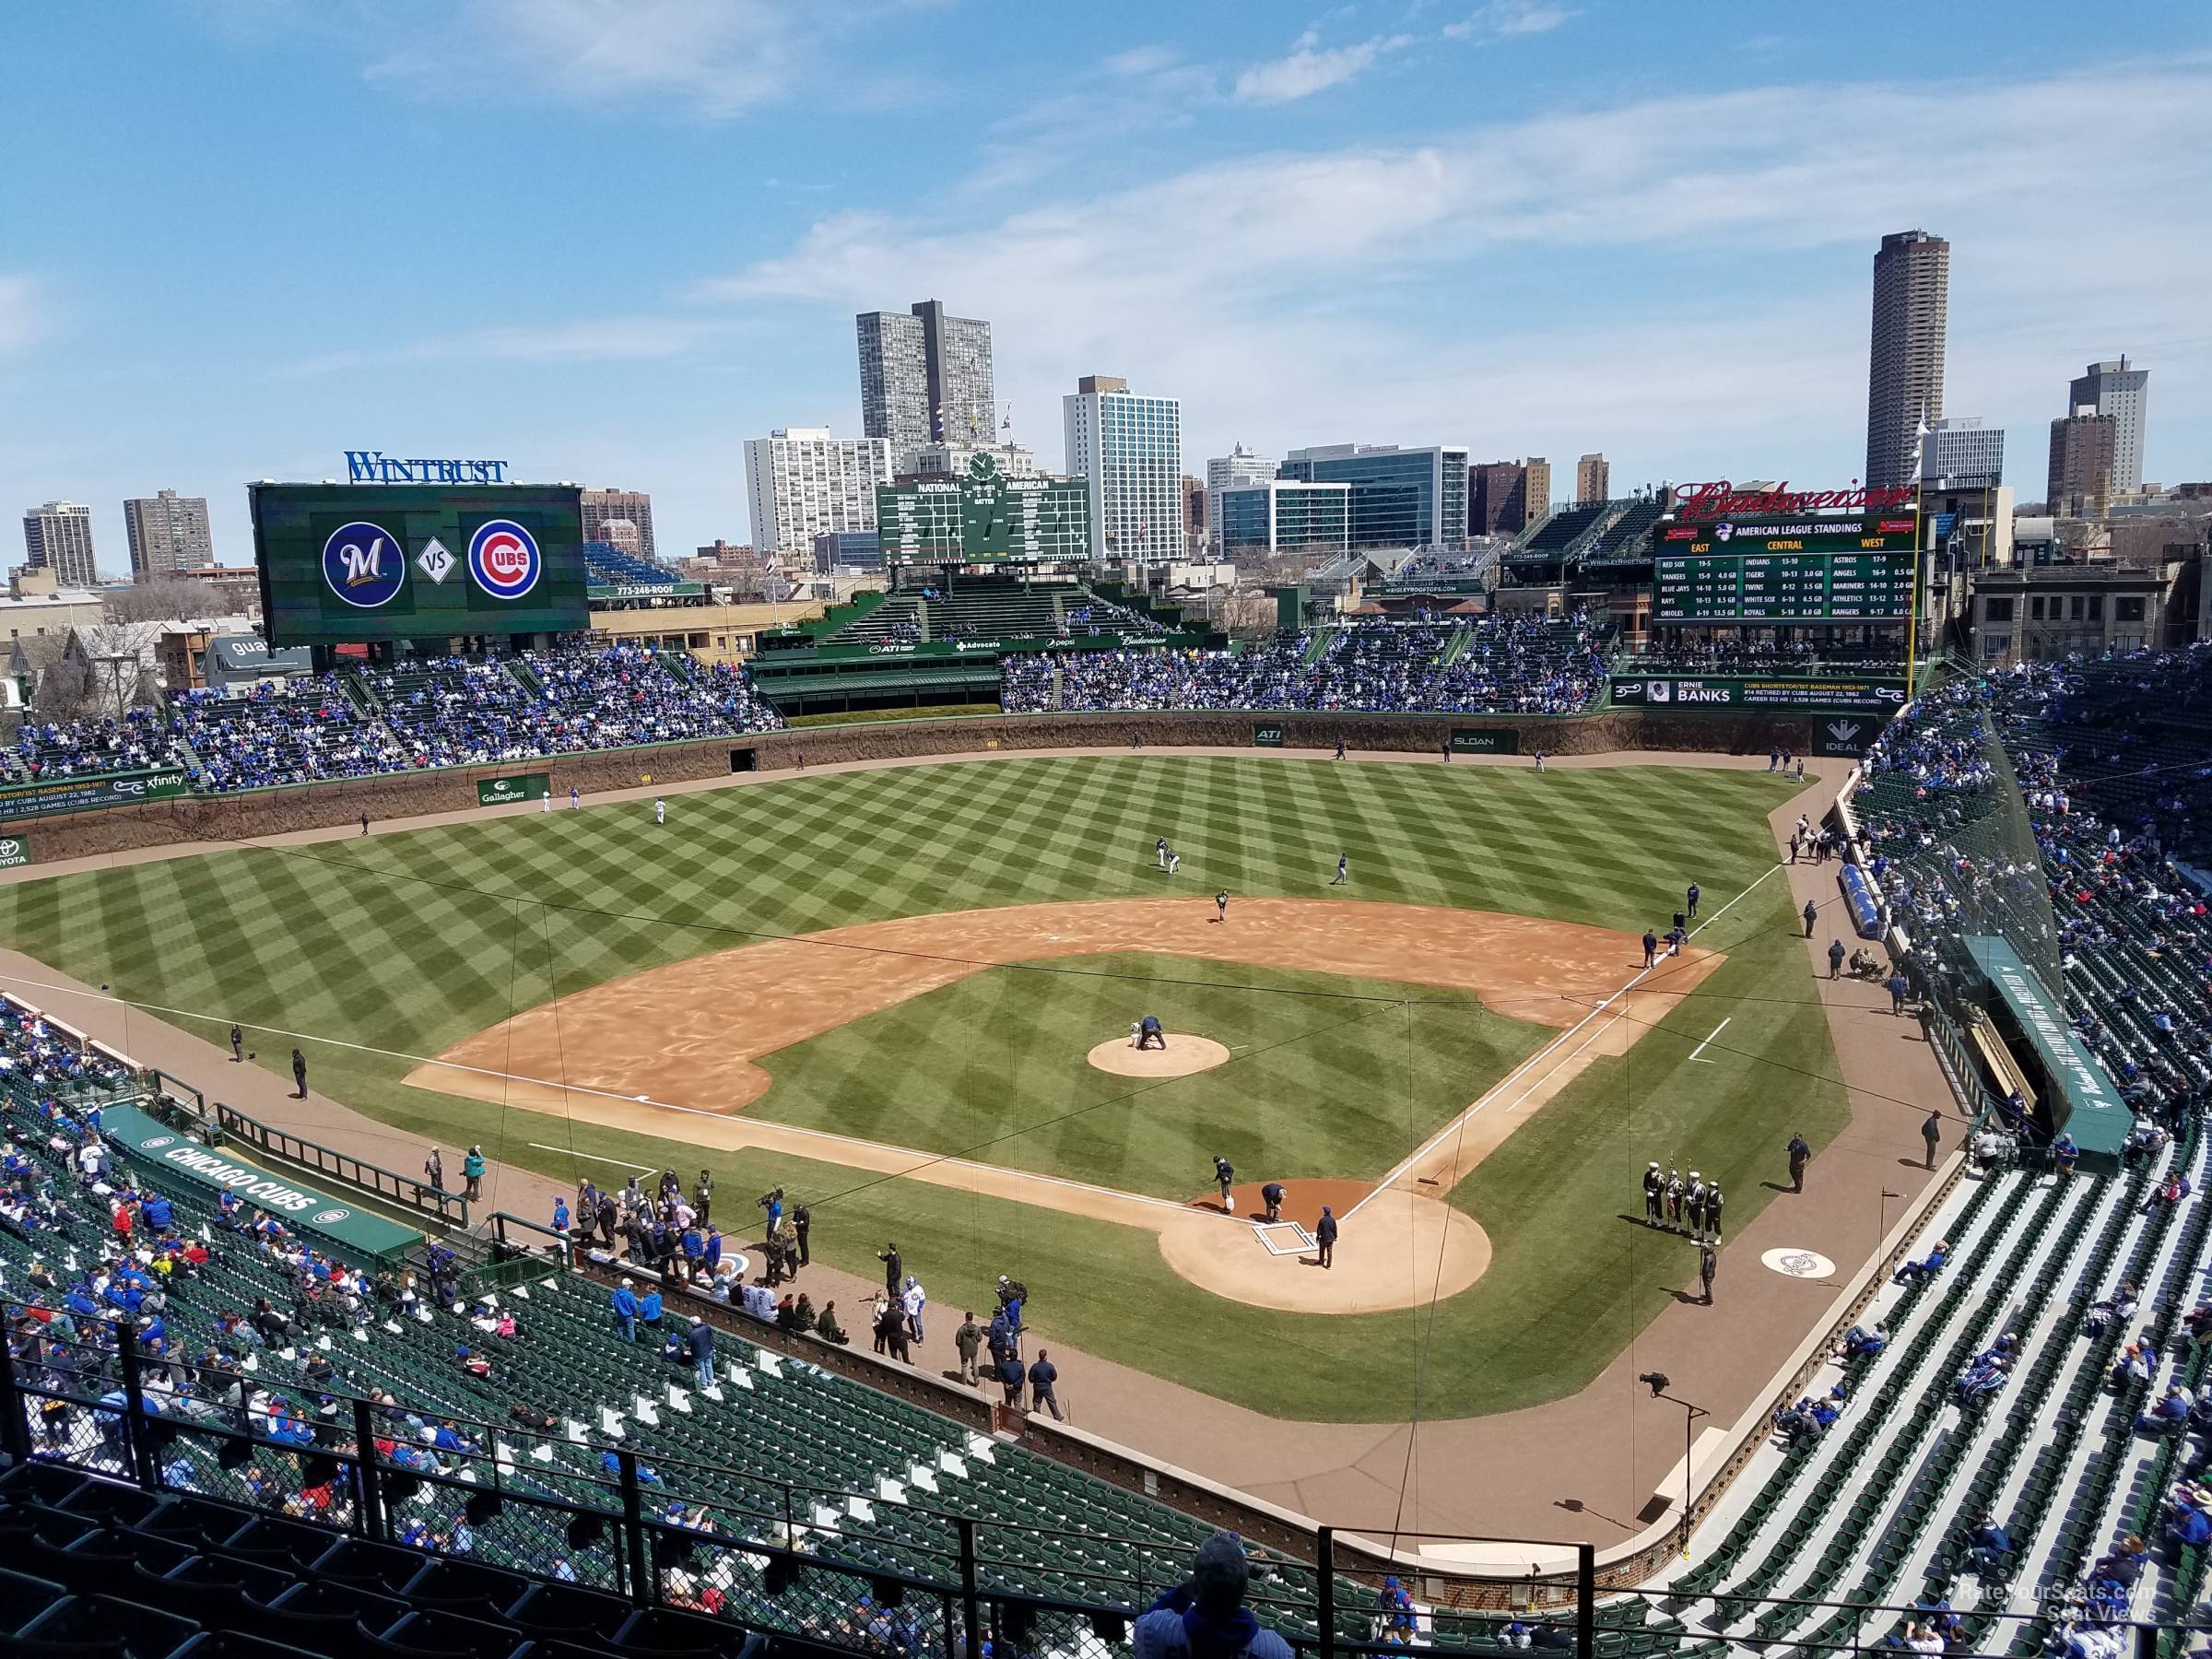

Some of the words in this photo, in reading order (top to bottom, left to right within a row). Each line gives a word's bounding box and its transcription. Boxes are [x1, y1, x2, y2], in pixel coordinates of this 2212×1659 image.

[344, 451, 508, 482] WINTRUST
[918, 483, 961, 493] NATIONAL
[1006, 480, 1049, 490] AMERICAN
[1675, 478, 1914, 519] Budweiser
[1736, 526, 1779, 536] AMERICAN
[1782, 524, 1812, 535] LEAGUE
[1814, 523, 1862, 534] STANDINGS
[1768, 540, 1803, 550] CENTRAL
[1861, 538, 1885, 547] WEST
[1691, 544, 1710, 552] EAST
[340, 536, 384, 582] M
[426, 551, 446, 571] VS
[483, 535, 527, 582] CUBS
[617, 585, 674, 595] 773-248-ROOF
[966, 641, 1000, 649] Advocate
[1055, 639, 1075, 647] pepsi
[1121, 636, 1166, 645] Budweiser
[1677, 689, 1731, 701] BANKS
[1257, 730, 1281, 738] ATI
[1826, 742, 1859, 751] IDEAL
[147, 773, 183, 789] xfinity
[39, 785, 73, 794] BASEMAN
[18, 796, 36, 805] CUBS
[41, 801, 65, 809] GAMES
[90, 794, 123, 803] RECORD)
[482, 791, 524, 802] Gallagher
[0, 856, 27, 865] YOTA
[164, 1147, 255, 1186] CHICAGO
[246, 1182, 317, 1210] CUBS
